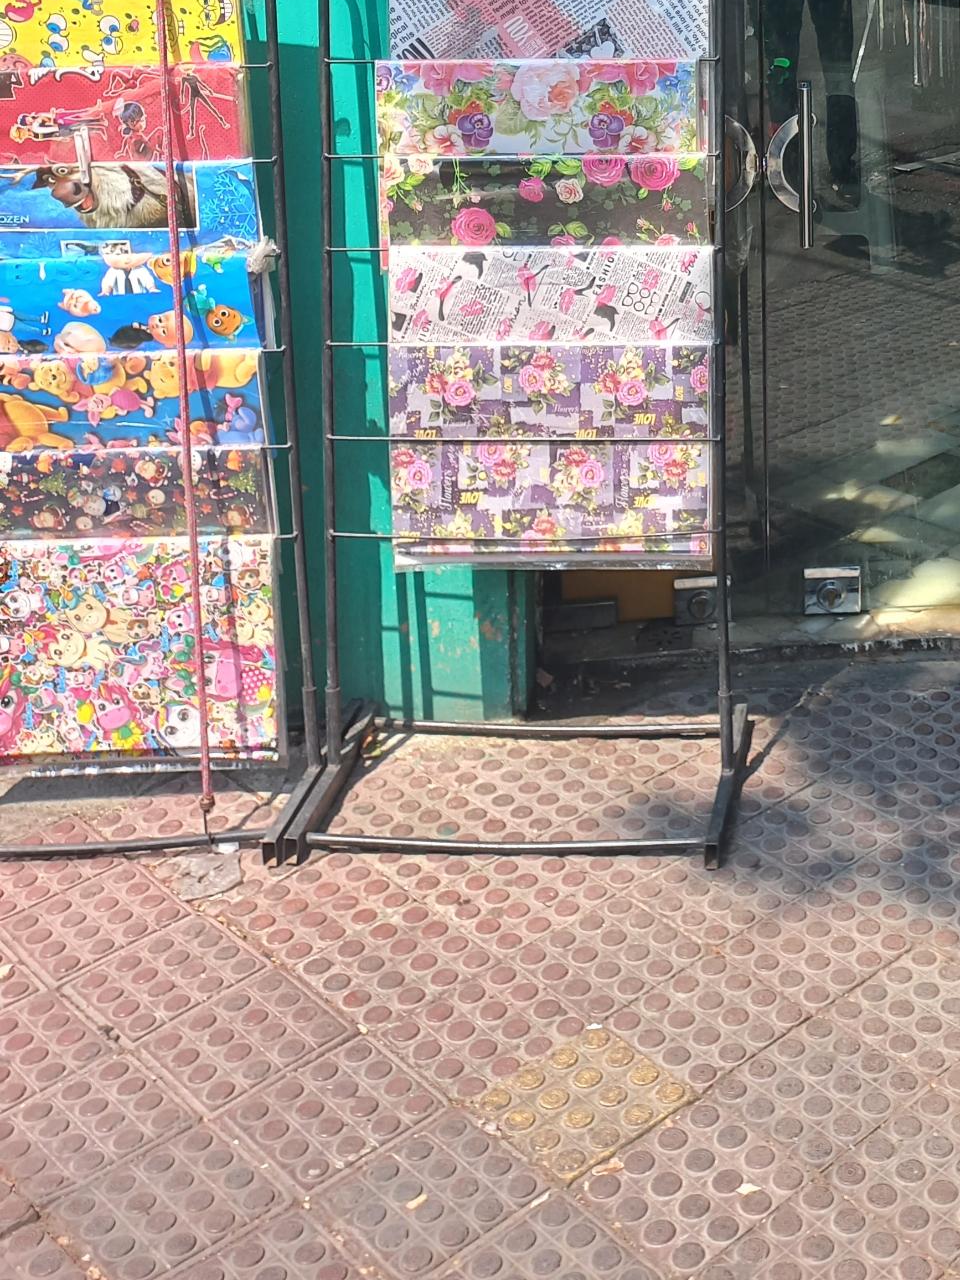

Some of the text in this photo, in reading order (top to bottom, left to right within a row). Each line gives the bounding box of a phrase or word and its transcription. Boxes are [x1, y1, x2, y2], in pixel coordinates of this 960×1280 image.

[500, 5, 520, 21] magic
[663, 8, 676, 21] you
[674, 10, 687, 25] love
[685, 10, 698, 24] you
[671, 21, 684, 35] Will
[633, 413, 656, 425] LOVE
[459, 490, 484, 505] LOVE
